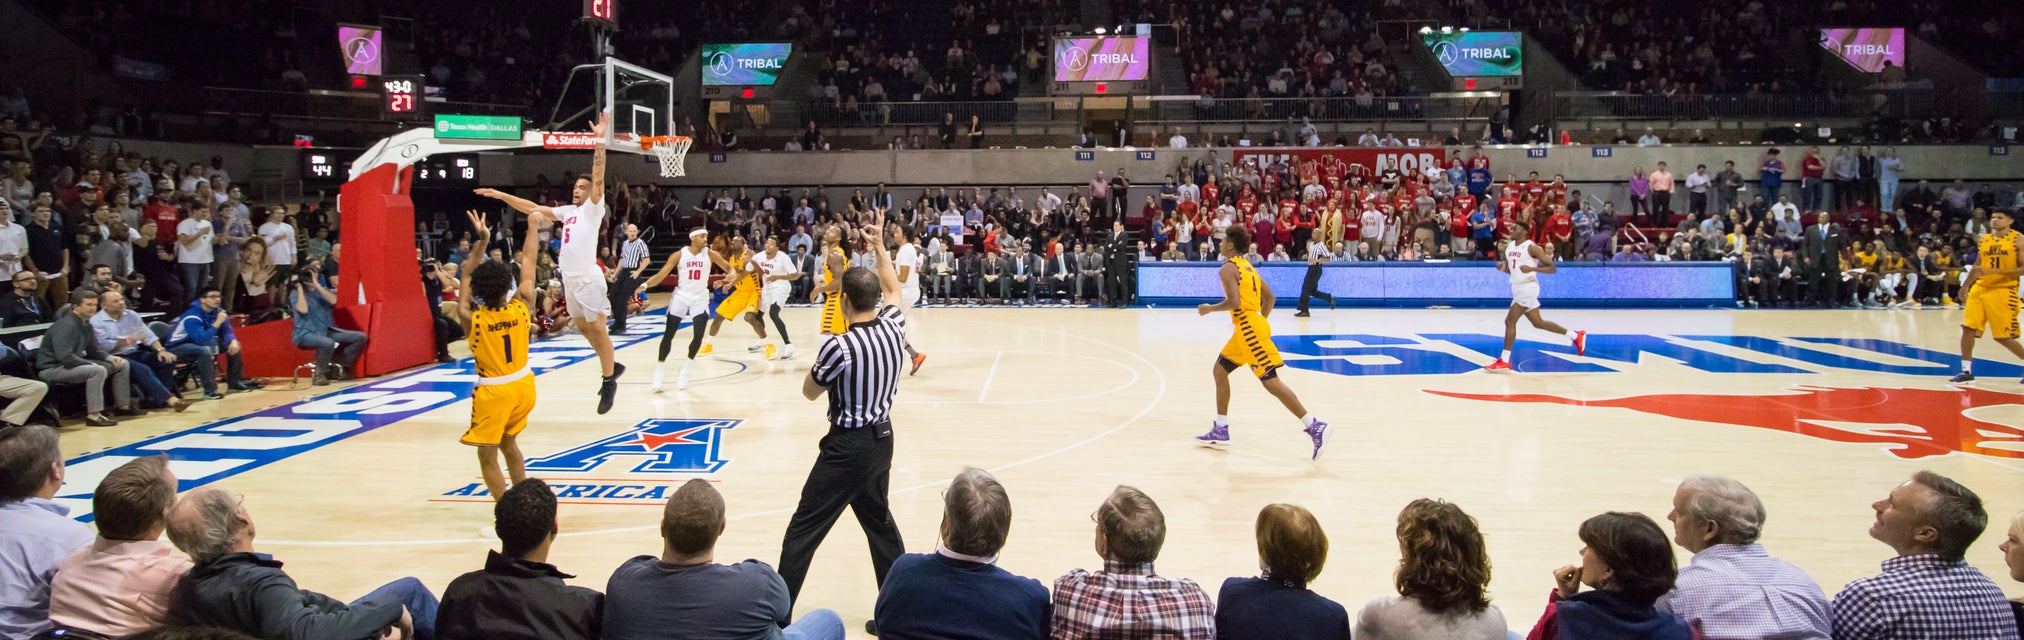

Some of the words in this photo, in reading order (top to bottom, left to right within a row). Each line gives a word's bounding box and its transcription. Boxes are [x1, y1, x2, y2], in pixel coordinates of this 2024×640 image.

[1462, 48, 1511, 59] TRIBAL
[1844, 44, 1893, 56] TRIBAL
[737, 58, 782, 69] TRIBAL
[1091, 53, 1139, 64] TRIBAL
[1055, 83, 1069, 91] 211
[1502, 77, 1519, 86] 213
[391, 94, 412, 112] 27
[490, 124, 518, 132] DALLAS
[560, 135, 581, 145] State
[581, 136, 597, 146] Far
[713, 154, 723, 162] 111
[1375, 153, 1435, 177] MOB
[312, 165, 332, 177] 44
[462, 167, 475, 179] 18
[564, 228, 571, 244] 5
[1512, 258, 1517, 269] 1
[688, 269, 702, 280] 10
[502, 334, 513, 364] 1
[442, 483, 671, 499] ARICA
